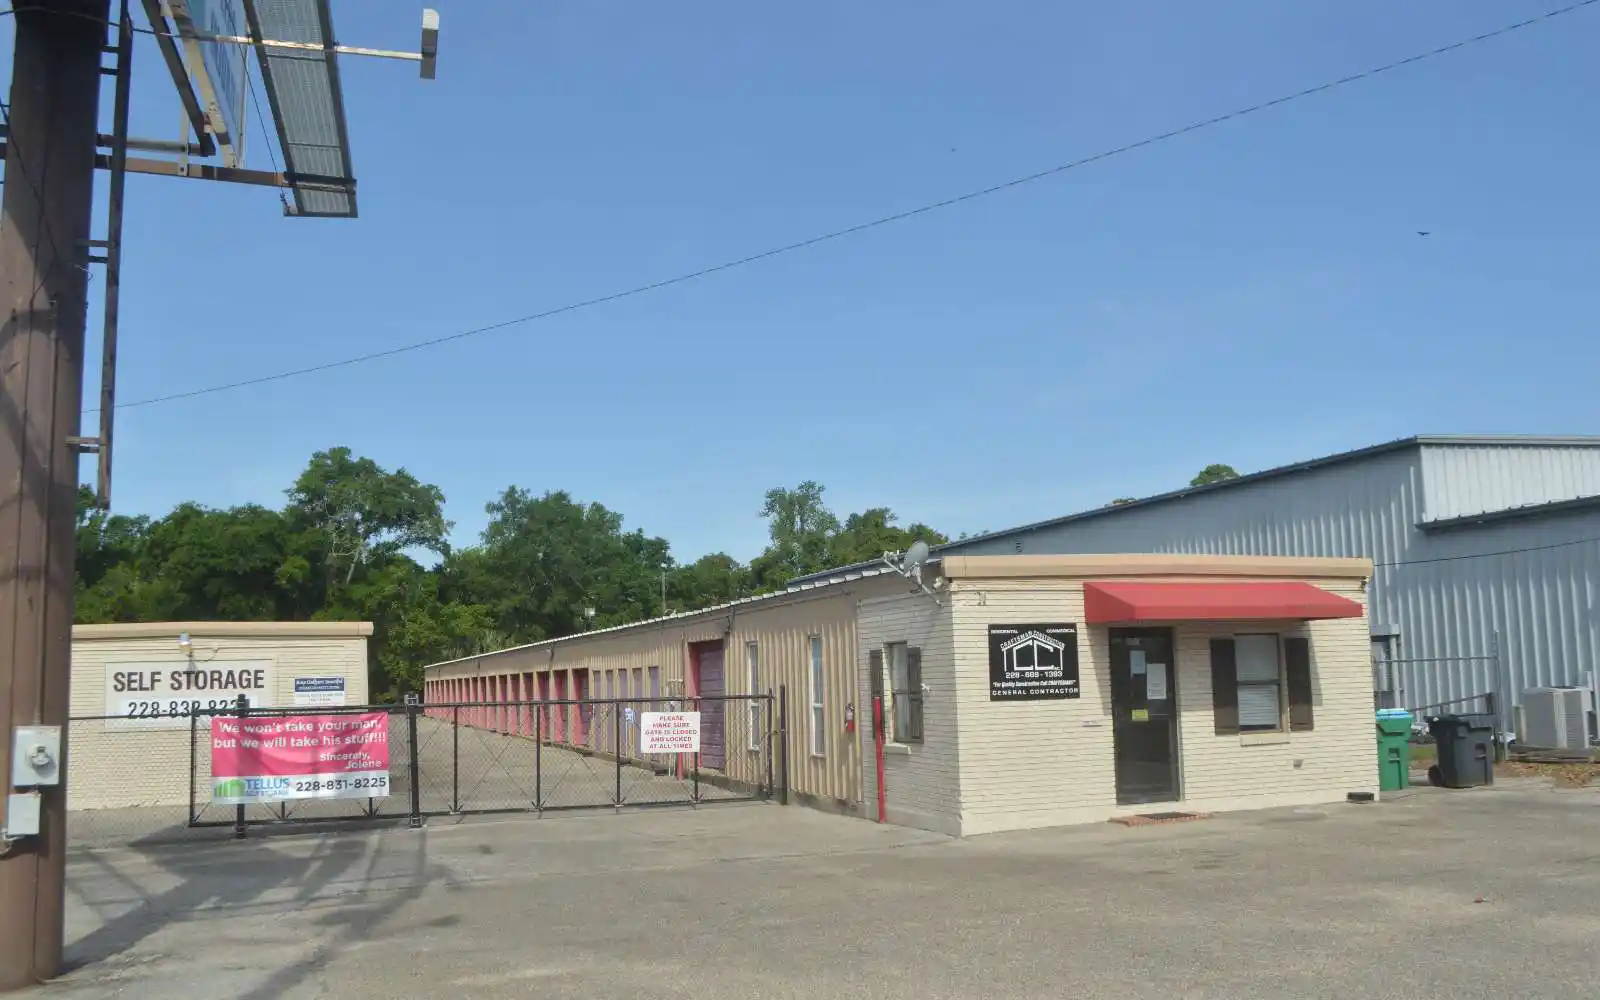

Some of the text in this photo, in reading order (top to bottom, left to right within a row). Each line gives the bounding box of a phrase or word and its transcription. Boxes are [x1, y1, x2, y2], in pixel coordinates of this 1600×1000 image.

[113, 670, 264, 692] SELF STORAGE
[220, 722, 240, 732] We
[244, 722, 282, 732] won't
[285, 721, 313, 732] take
[318, 720, 348, 732] your
[214, 732, 386, 748] but we will take his stuff!!!
[320, 752, 370, 760] Sincerely,
[345, 760, 382, 768] Jolene
[244, 778, 290, 790] TELLUS
[296, 776, 386, 792] 228-831-8225
